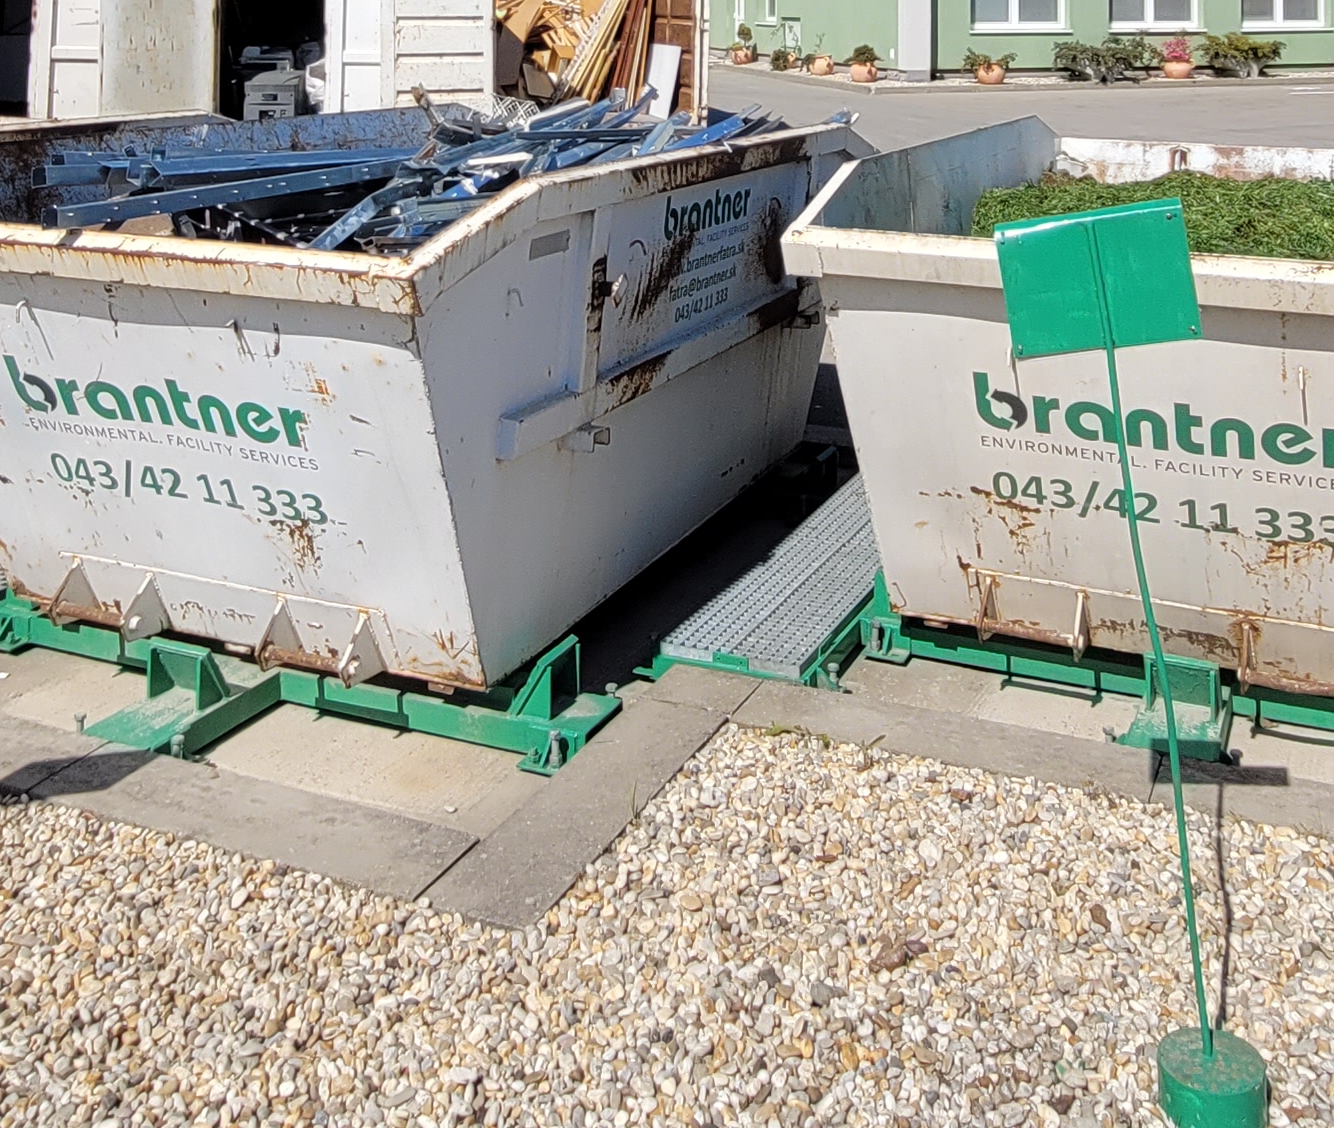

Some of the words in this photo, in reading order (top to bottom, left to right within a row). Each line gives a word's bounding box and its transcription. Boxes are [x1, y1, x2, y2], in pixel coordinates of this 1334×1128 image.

[664, 188, 751, 240] brantner
[703, 292, 713, 310] 11
[714, 287, 728, 306] 333
[2, 354, 306, 448] brantner
[167, 434, 233, 456] FACILITY
[239, 447, 319, 471] SERVICES
[980, 435, 1147, 470] ENVIRONMENTL.
[1154, 458, 1243, 480] FACILITY
[50, 452, 189, 499] 043/42
[196, 473, 245, 511] 11
[252, 484, 329, 525] 333
[992, 471, 1161, 524] 043/42
[1177, 499, 1239, 534] 11
